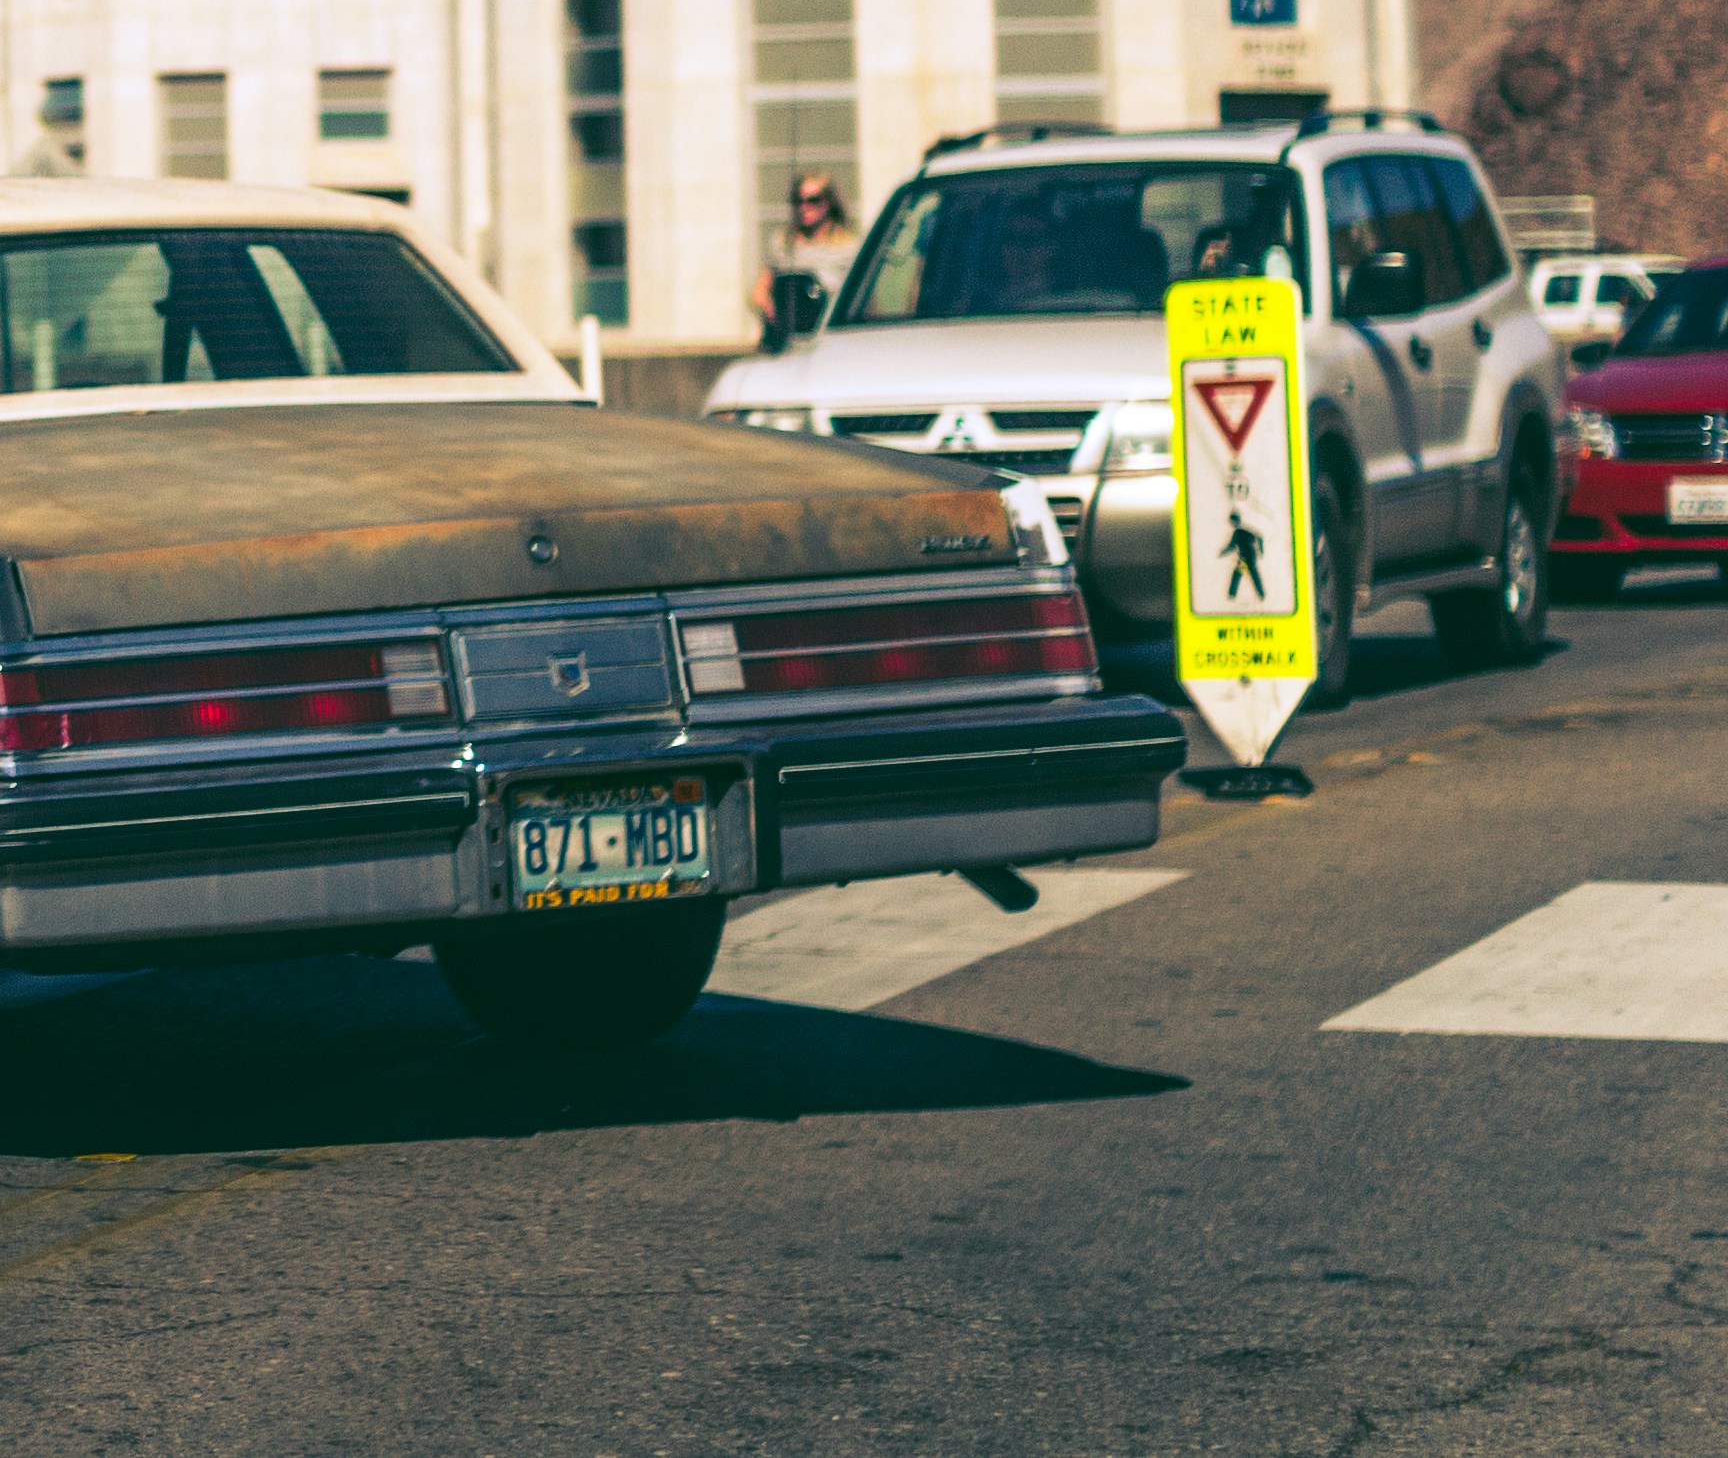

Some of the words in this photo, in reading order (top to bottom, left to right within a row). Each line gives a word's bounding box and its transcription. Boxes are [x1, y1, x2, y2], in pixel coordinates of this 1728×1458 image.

[1191, 296, 1268, 320] STATE
[1204, 327, 1257, 346] LAW
[1217, 626, 1274, 640] WITHIN
[1194, 651, 1297, 669] CROSSWALK
[570, 885, 620, 905] PAID
[628, 880, 669, 900] FOR
